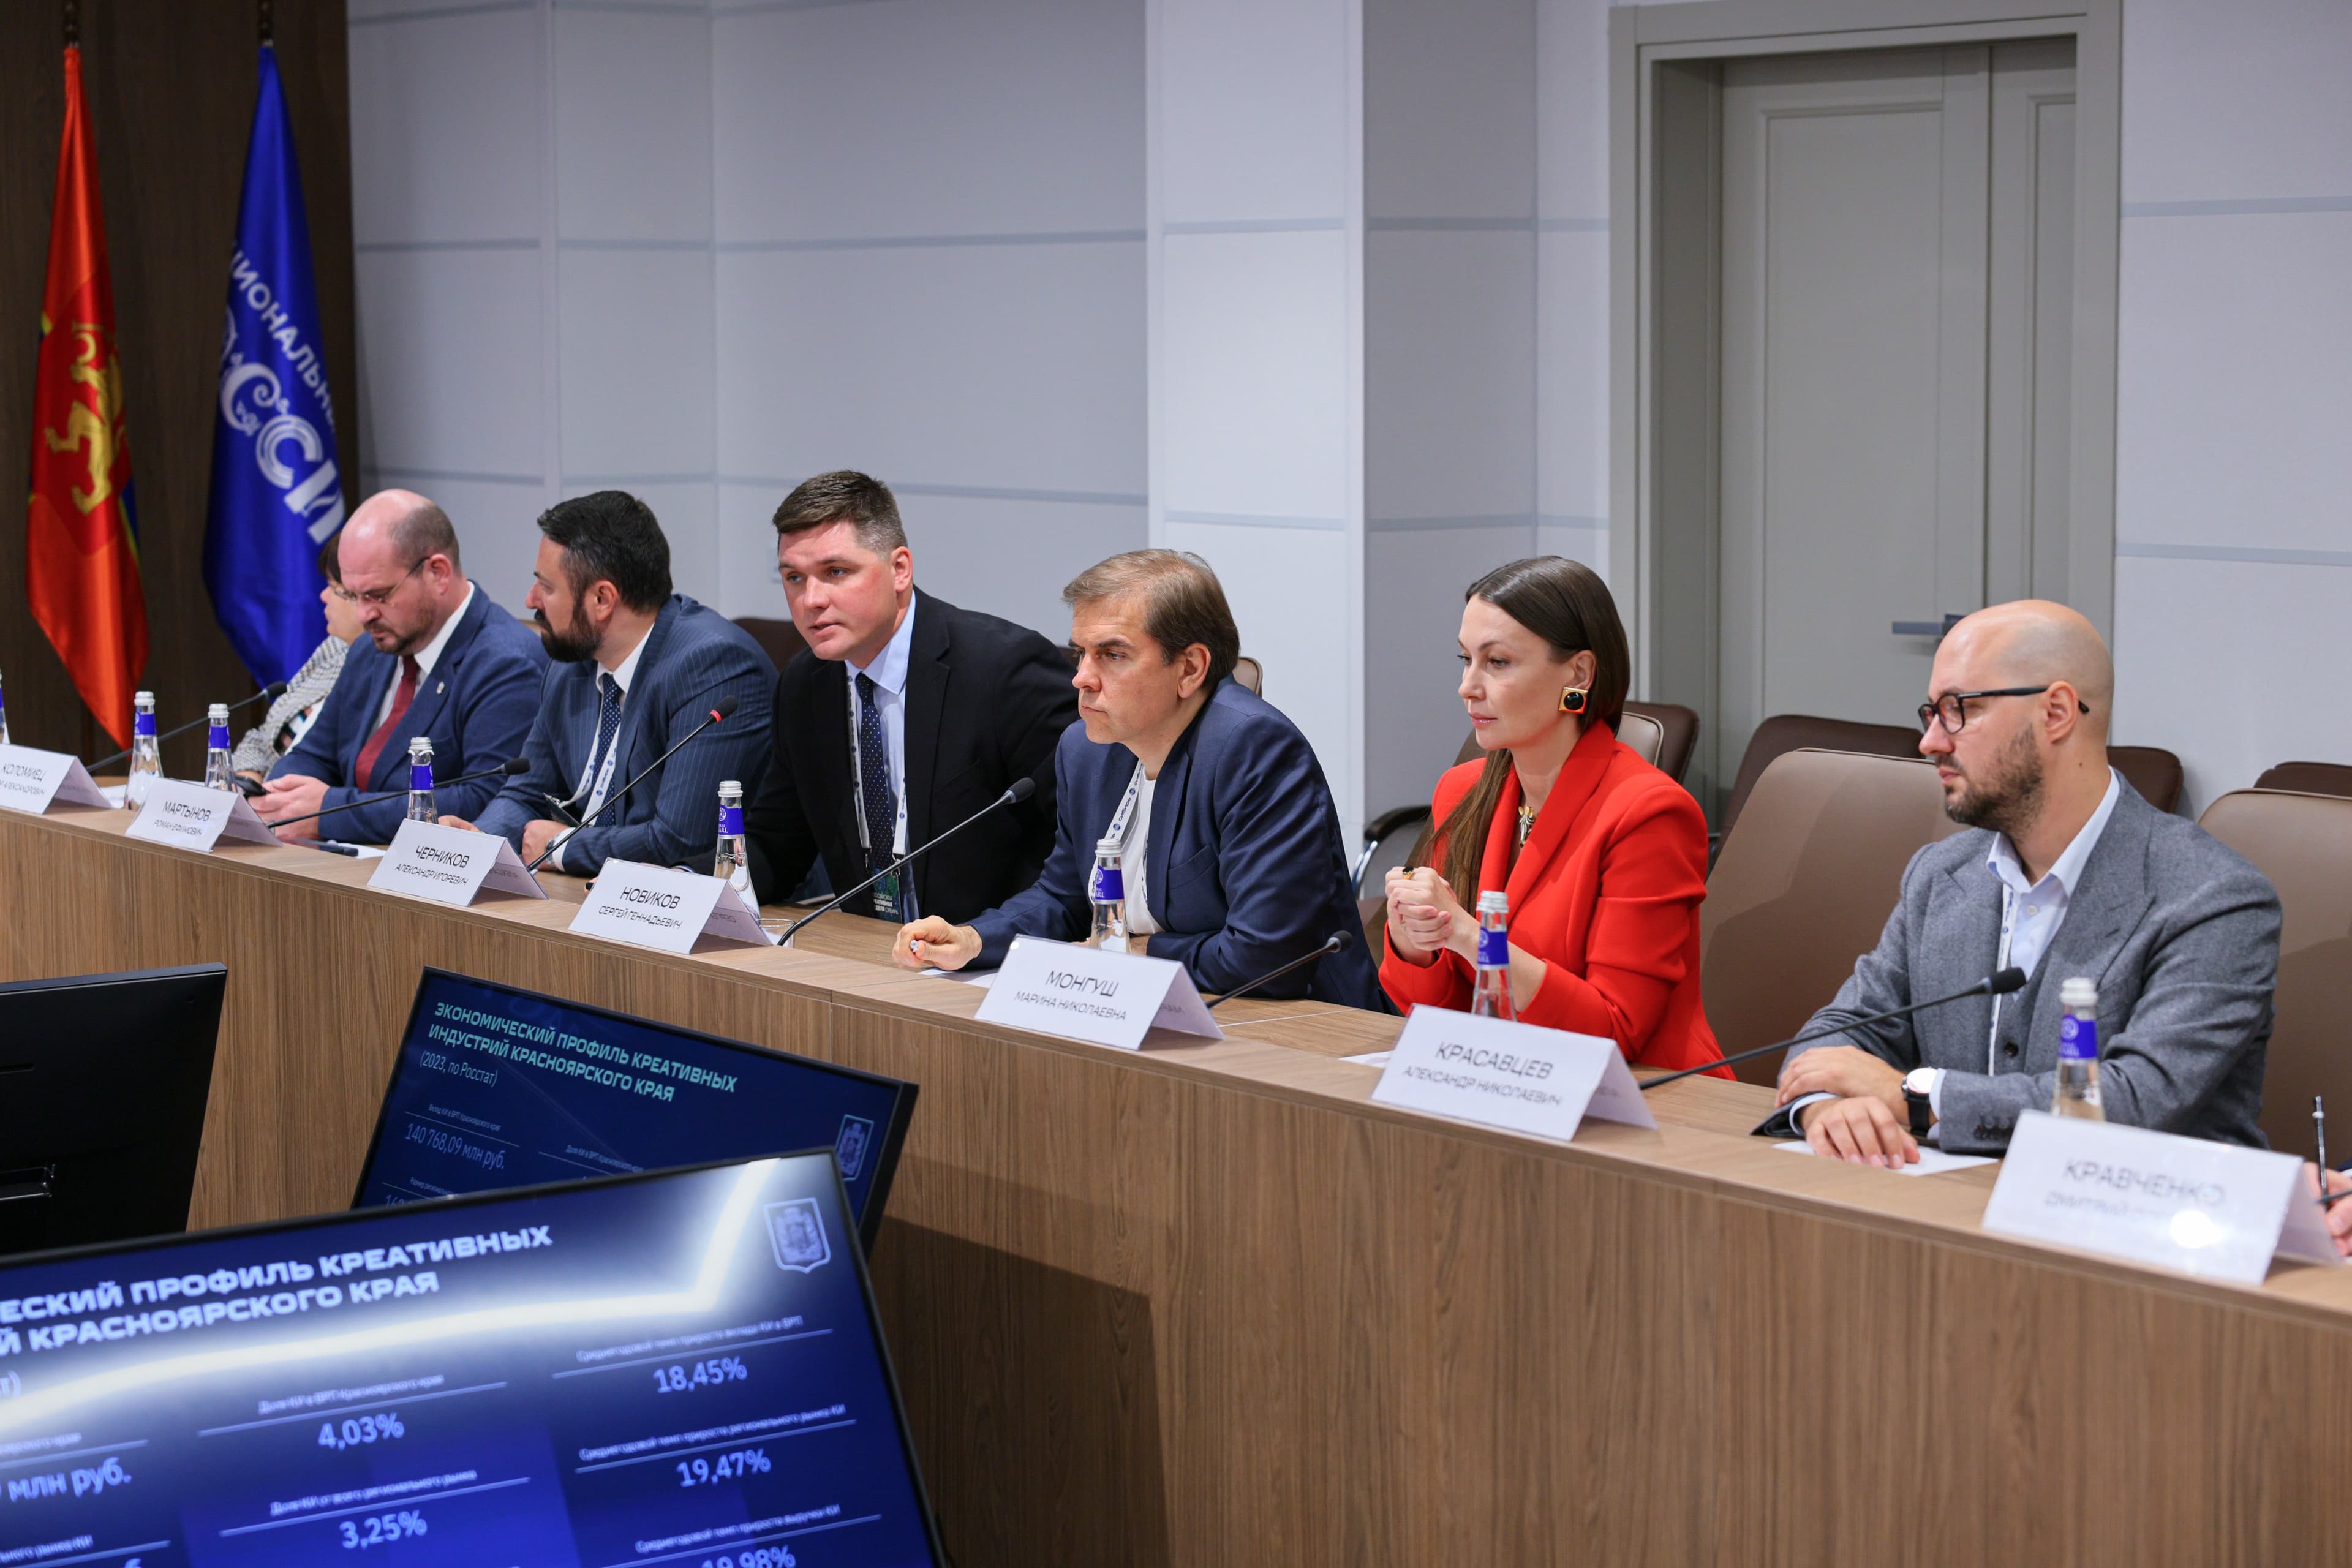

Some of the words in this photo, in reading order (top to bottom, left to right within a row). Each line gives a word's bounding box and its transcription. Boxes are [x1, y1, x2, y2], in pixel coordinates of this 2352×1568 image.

[1, 763, 47, 782] КОЛОМИЕЦ
[154, 819, 173, 828] РОМАН
[162, 801, 211, 822] МАРТЫНОВ
[394, 863, 435, 878] АЛЕКСАНДР
[433, 870, 469, 886] ИГОРЕВИЧ
[415, 845, 470, 869] ЧЕРНИКОВ
[619, 886, 681, 910] НОВИКОВ
[598, 905, 629, 919] СЕРГЕЙ
[627, 911, 683, 930] ГЕННАДЬЕВИЧ
[1045, 970, 1119, 997] МОНГУШ
[1014, 991, 1057, 1008] МАРИНА
[1058, 999, 1127, 1020] НИКОЛАЕВНА
[428, 1024, 510, 1058] ИНДУСТРИЙ
[510, 1045, 633, 1091] КРАСНОЯРСКОГО
[633, 1078, 675, 1102] КРАЯ
[435, 1002, 556, 1045] ЭКОНОМИЧЕСКИЙ
[556, 1033, 630, 1065] ПРОФИЛЬ
[631, 1052, 738, 1093] КРЕАТИВНЫХ
[1434, 1041, 1553, 1080] КРАСАВЦЕВ
[420, 1050, 446, 1073] (2023,
[447, 1061, 460, 1075] по
[460, 1061, 498, 1088] Росстат)
[1402, 1065, 1476, 1090] АЛЕКСАНДР
[1477, 1078, 1564, 1106] НИКОЛАЕВИЧ
[405, 1123, 427, 1144] 140
[427, 1129, 463, 1155] 768,09
[462, 1144, 484, 1162] млн
[482, 1150, 505, 1170] руб.
[2062, 1158, 2226, 1207] КРАВЧЕНКО
[130, 1256, 315, 1306] ПРОФИЛЬ
[318, 1225, 552, 1278] КРЕАТИВНЫХ
[28, 1284, 343, 1352] КРАСНОЯРСКОГО
[349, 1271, 440, 1304] КРАЯ
[653, 1356, 748, 1393] 18,45%
[318, 1412, 405, 1450] 4,03%
[7, 1472, 67, 1502] млн
[71, 1457, 132, 1498] руб.
[676, 1448, 772, 1487] 19,47%
[339, 1509, 429, 1550] 3,25%
